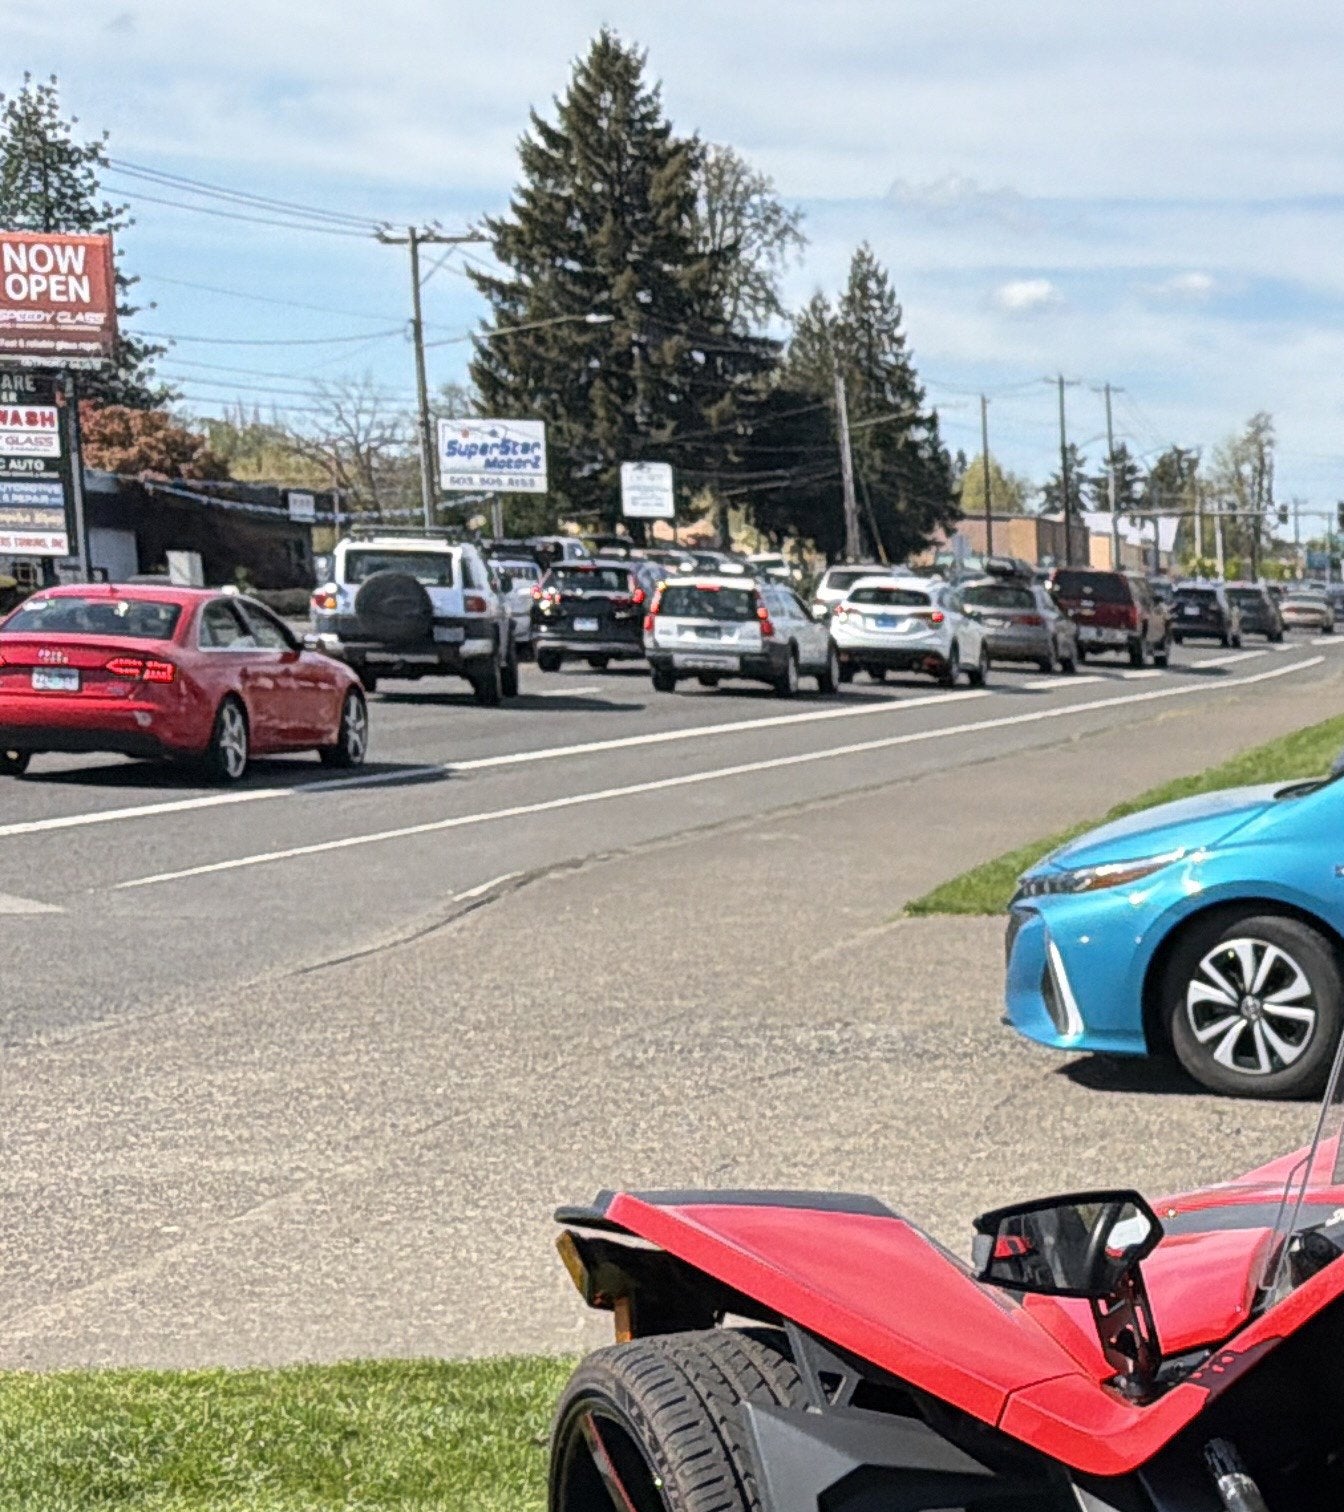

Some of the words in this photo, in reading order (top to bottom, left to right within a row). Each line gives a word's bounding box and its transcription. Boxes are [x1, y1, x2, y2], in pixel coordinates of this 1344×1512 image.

[2, 243, 86, 275] NOW
[5, 273, 91, 303] OPEN
[9, 458, 45, 471] AUTO
